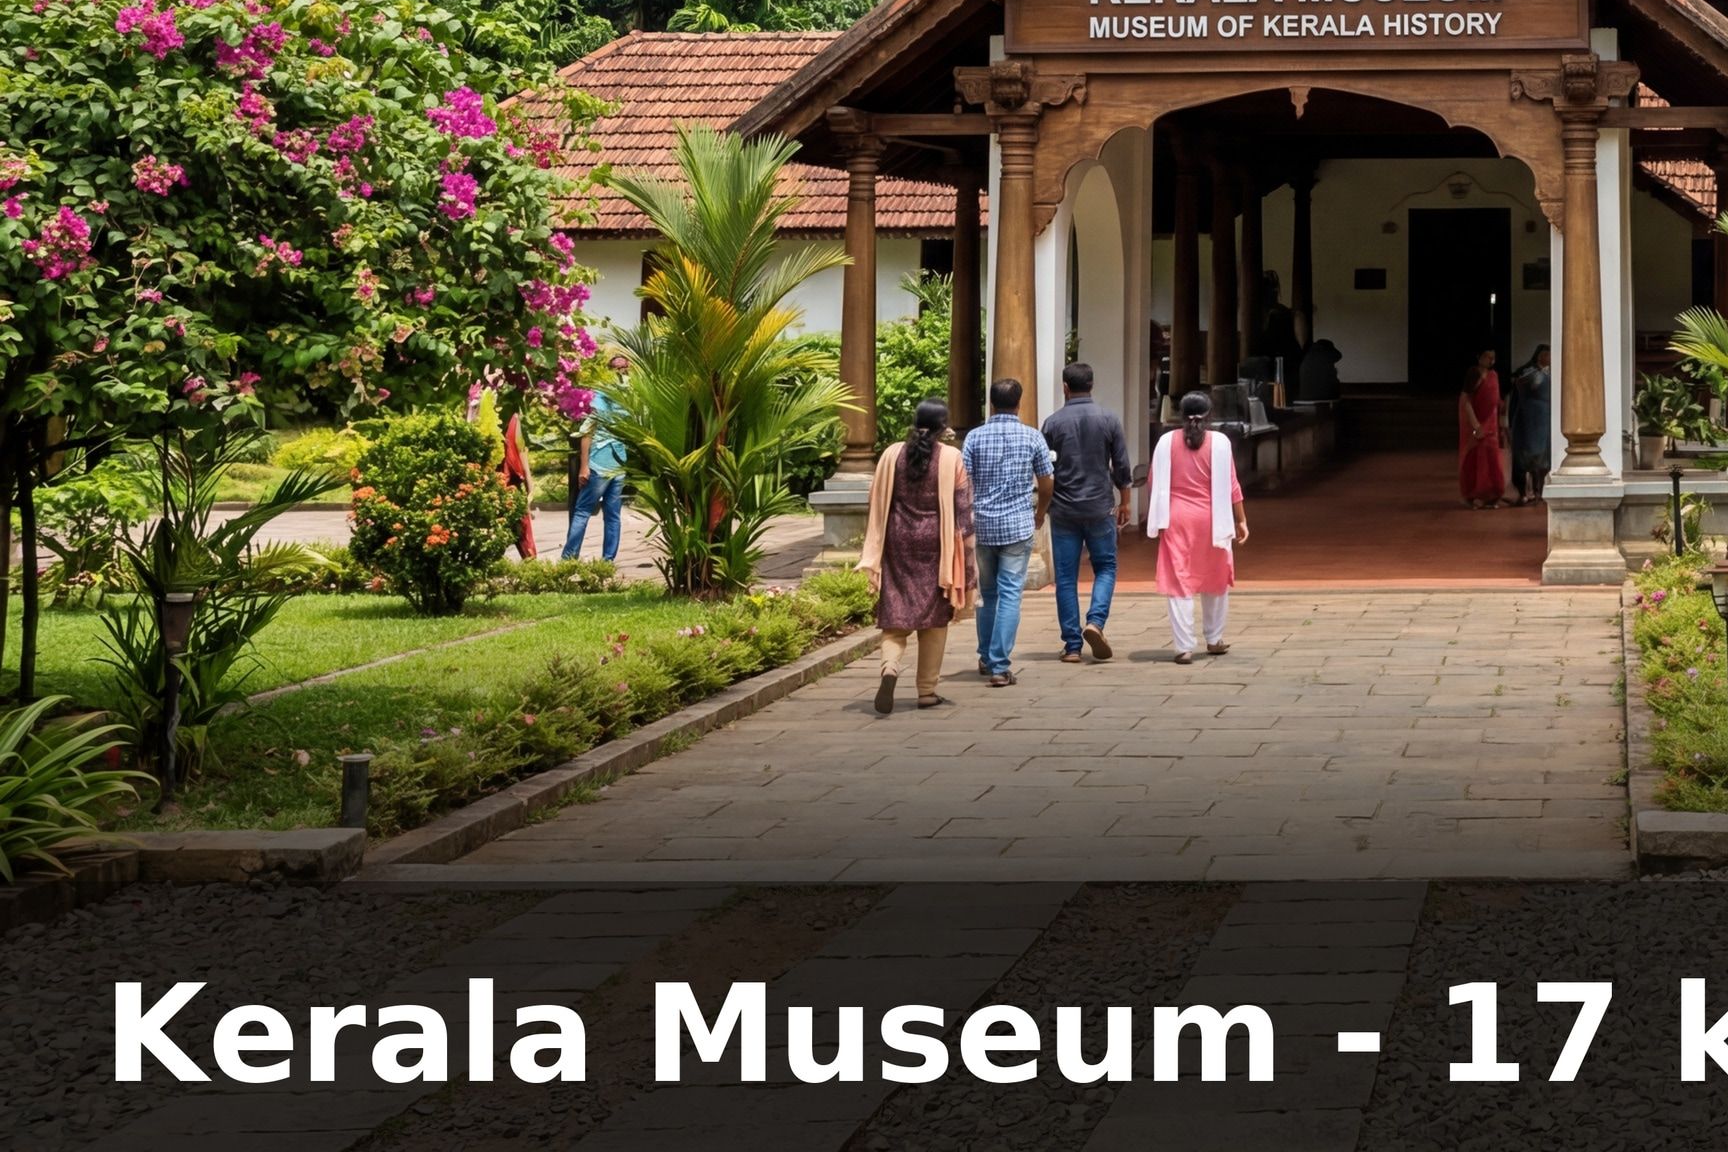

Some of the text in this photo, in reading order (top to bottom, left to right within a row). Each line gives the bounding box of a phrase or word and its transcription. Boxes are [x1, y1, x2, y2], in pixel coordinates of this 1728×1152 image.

[1089, 12, 1502, 39] MUSEUM OF KERALA HISTORY
